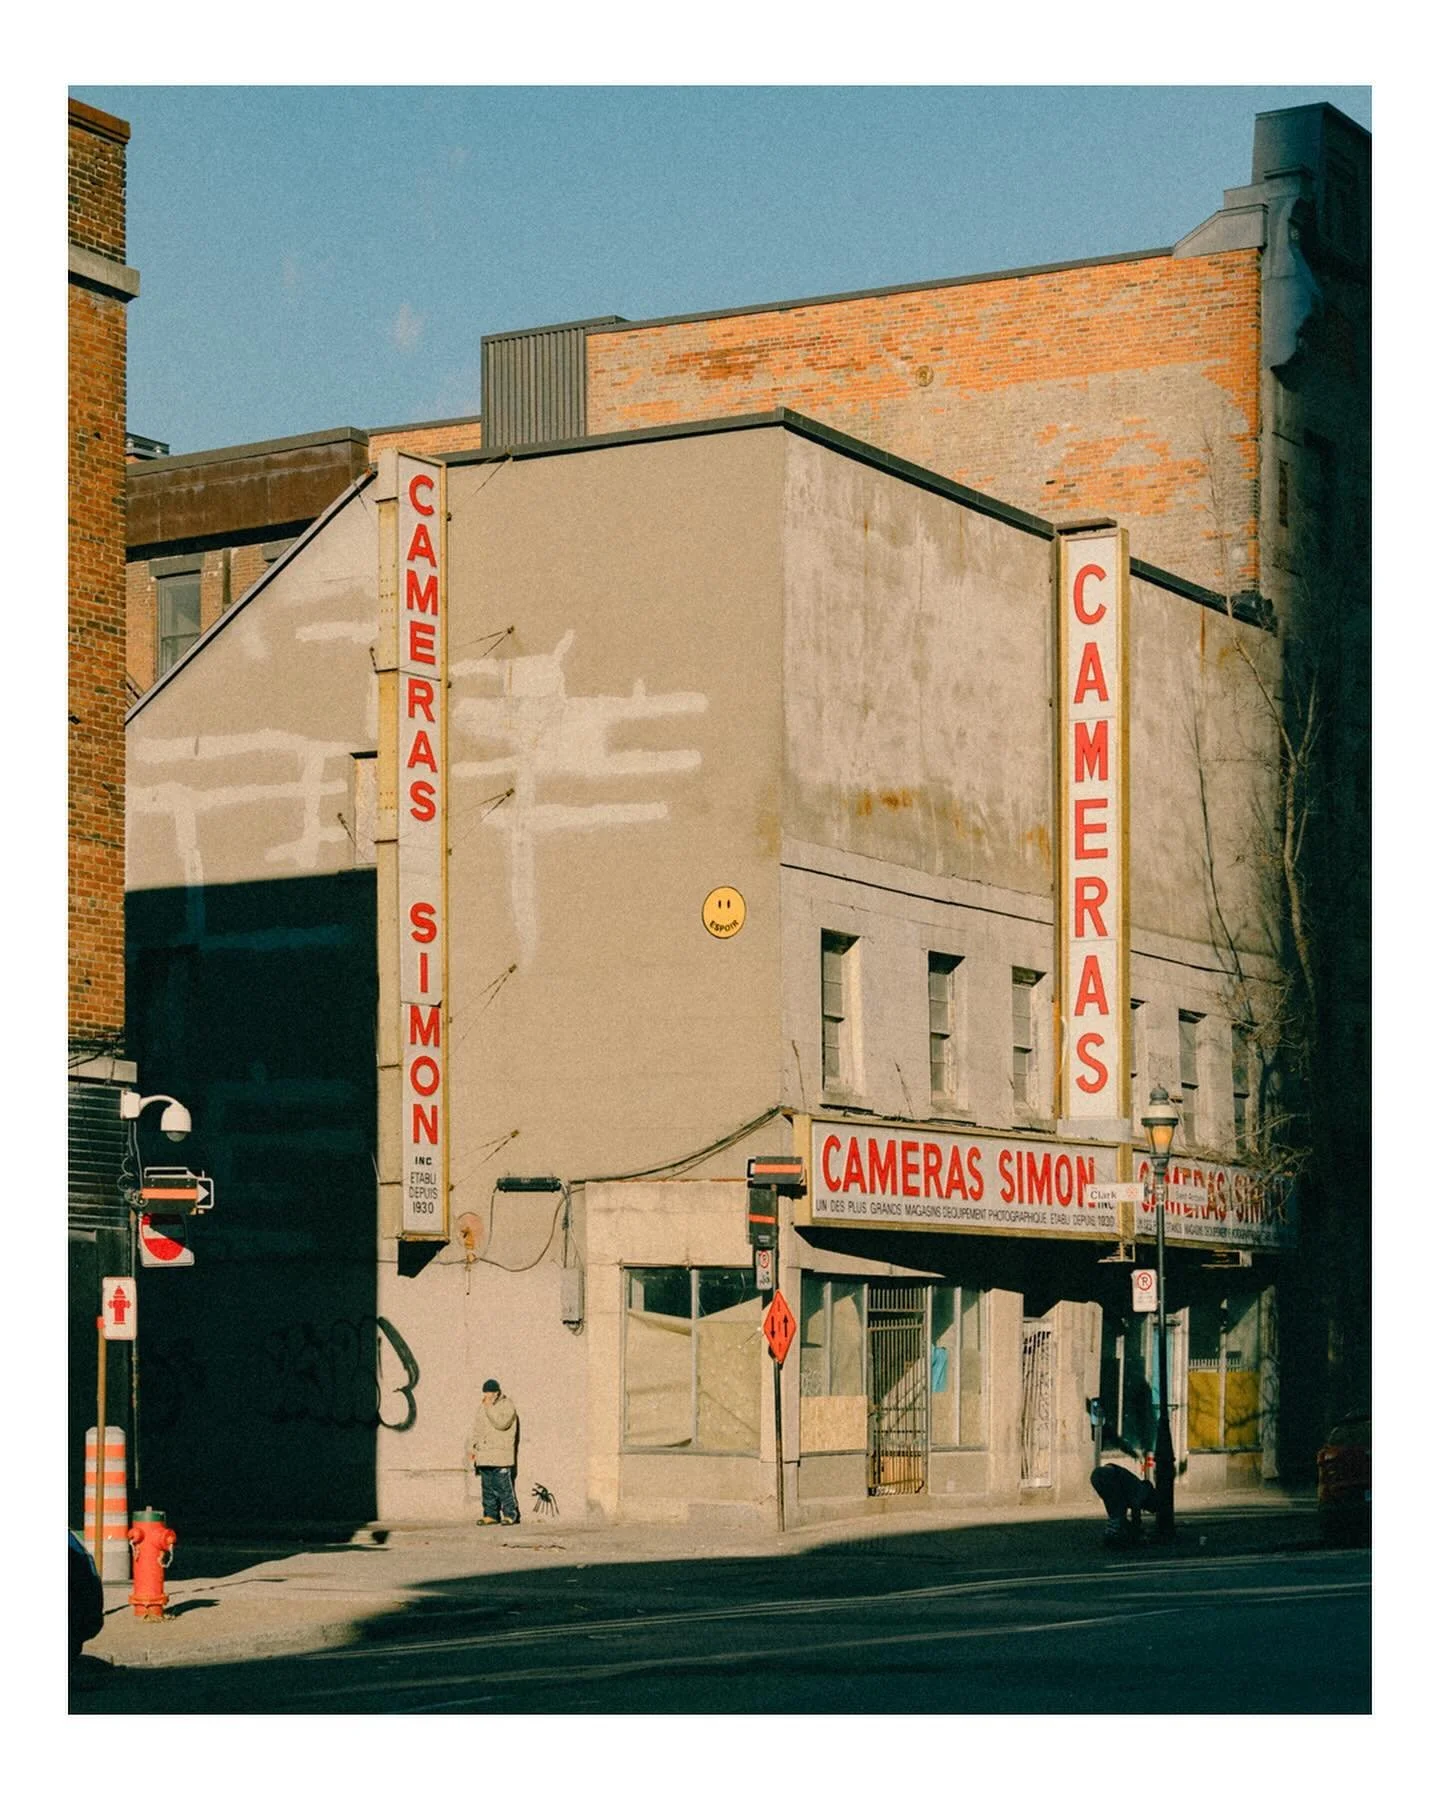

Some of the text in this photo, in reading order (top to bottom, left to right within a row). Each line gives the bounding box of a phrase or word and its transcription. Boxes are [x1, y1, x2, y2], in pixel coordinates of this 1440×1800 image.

[406, 474, 440, 1145] CAMERAS SIMON
[1073, 563, 1110, 1095] CAMERAS
[709, 919, 739, 932] ESPOIR
[415, 1156, 432, 1165] INC
[822, 1134, 1095, 1208] CAMERAS SIMON
[410, 1172, 437, 1184] ETABLI
[408, 1186, 439, 1199] DEPUIS
[1090, 1190, 1117, 1200] Clark
[412, 1201, 435, 1214] 1930
[816, 1199, 828, 1212] UN
[830, 1200, 845, 1213] DES
[848, 1201, 867, 1214] PLUS
[870, 1202, 902, 1216] GRANDS
[904, 1204, 942, 1218] MAGASINS
[1072, 1214, 1096, 1227] DEPUIS
